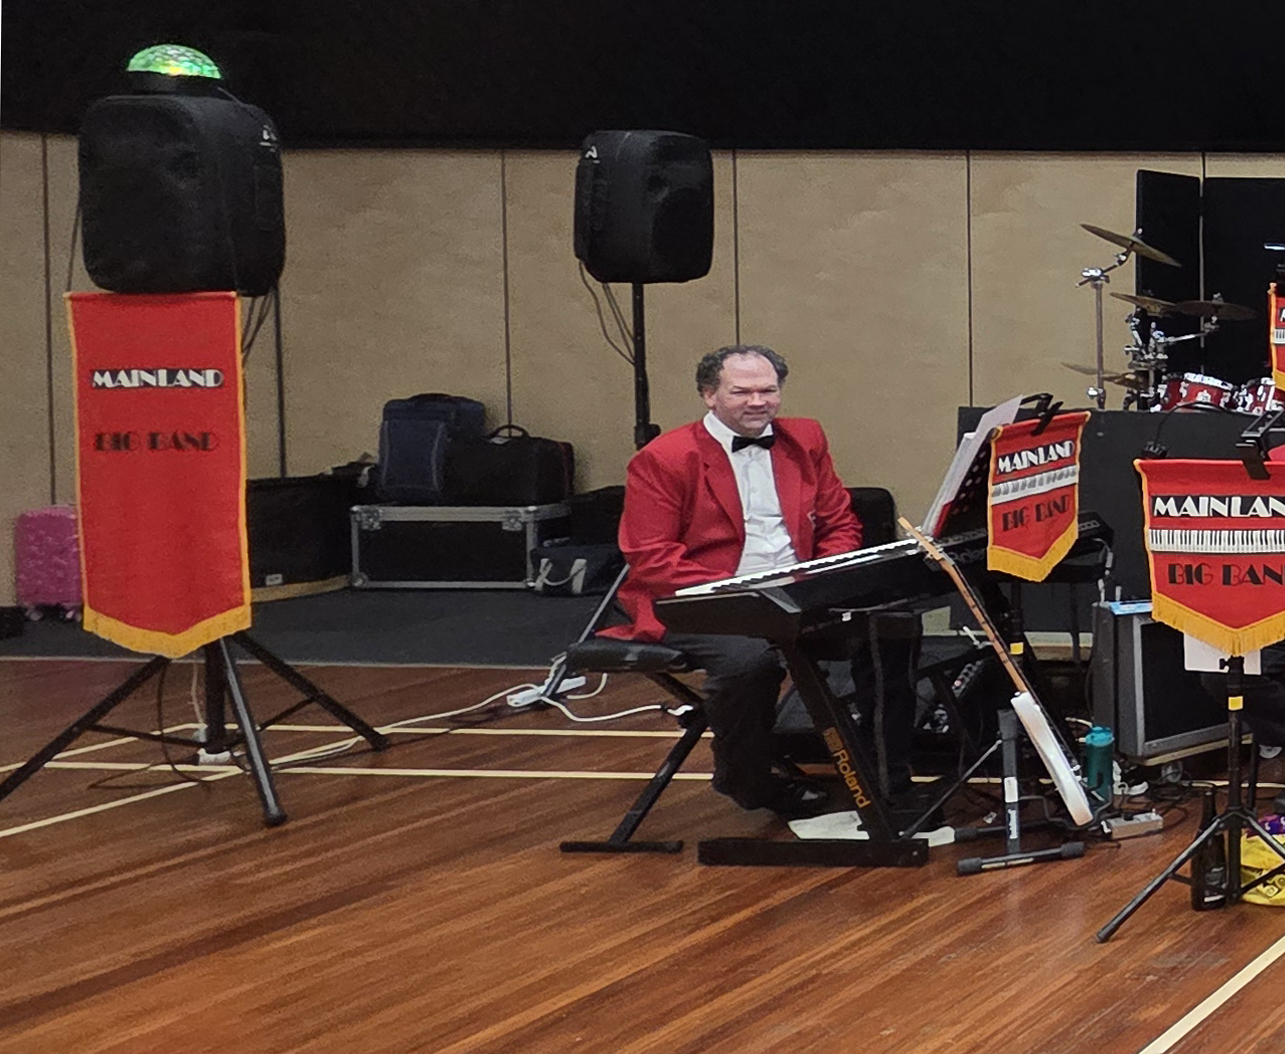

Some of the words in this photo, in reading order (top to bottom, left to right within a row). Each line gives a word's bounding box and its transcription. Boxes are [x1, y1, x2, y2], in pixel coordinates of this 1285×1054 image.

[93, 368, 223, 388] MAINLAND
[997, 440, 1075, 474] MAINLAND
[1168, 563, 1213, 585] BIG
[832, 749, 871, 809] Roland
